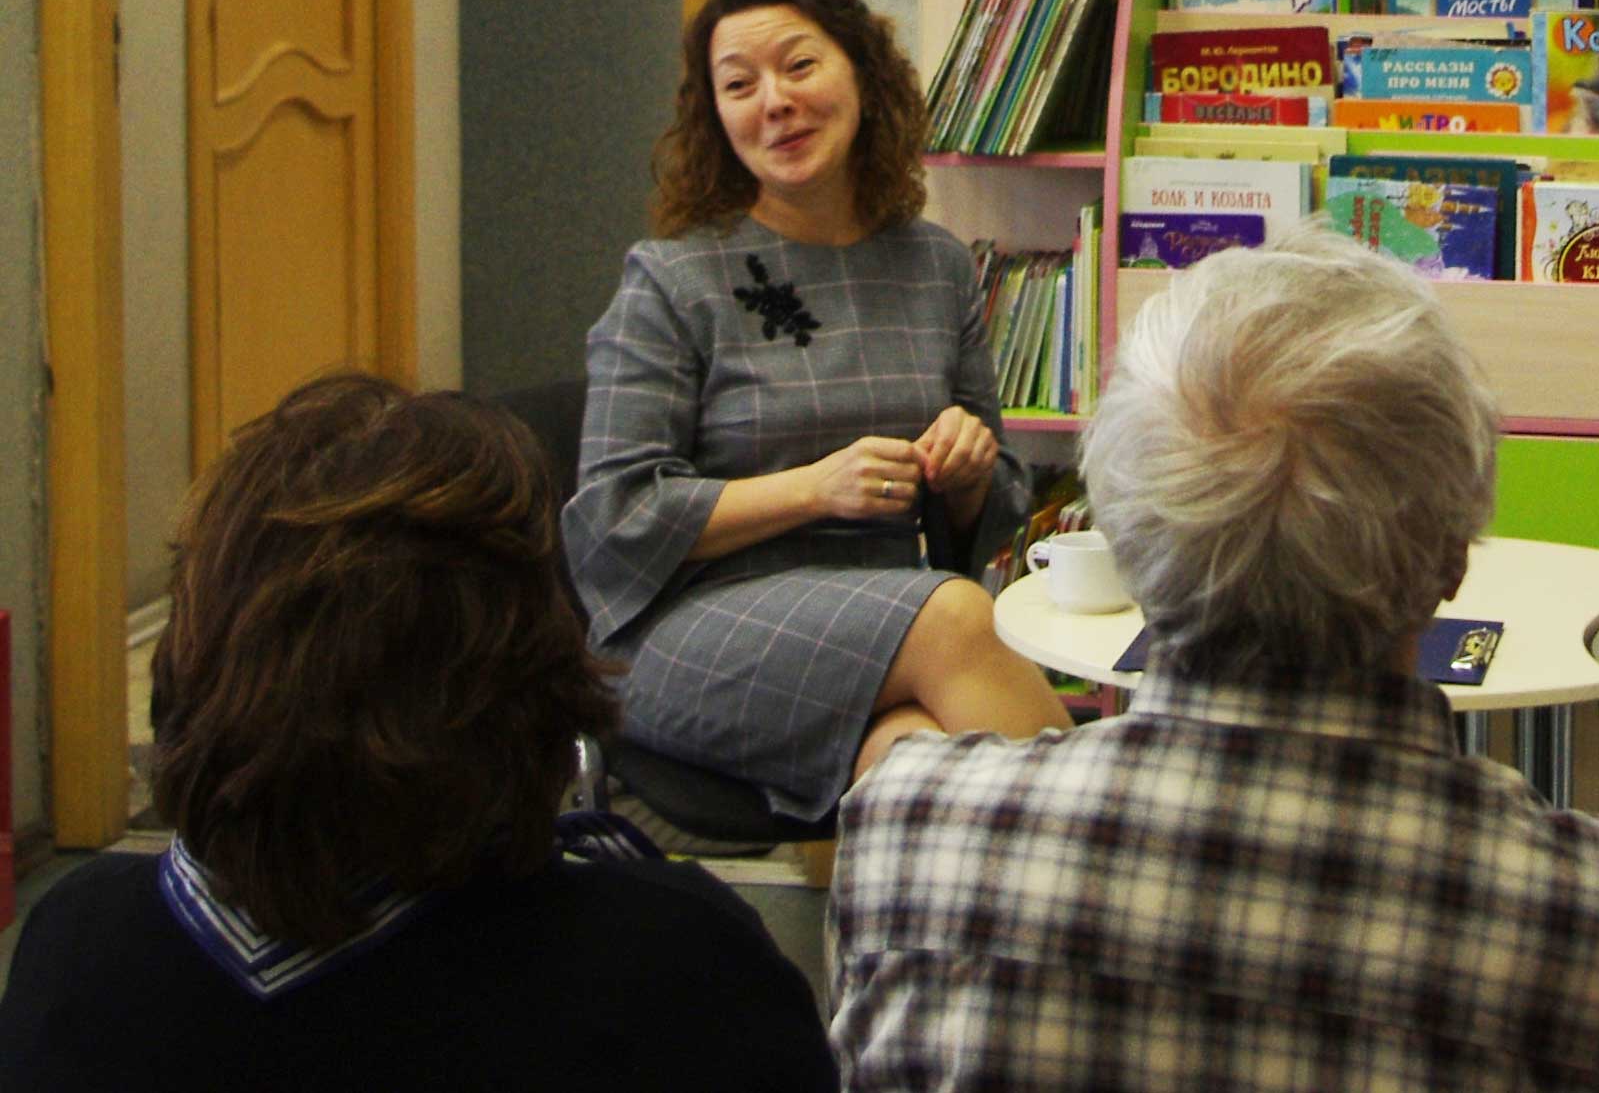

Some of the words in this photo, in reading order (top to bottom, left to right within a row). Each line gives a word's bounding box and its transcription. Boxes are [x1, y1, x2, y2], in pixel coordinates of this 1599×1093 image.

[1382, 61, 1475, 74] РАССКАЗЫ
[1161, 60, 1323, 95] БОРОДИНО
[1387, 76, 1420, 88] ПРО
[1425, 76, 1471, 89] МЕНЯ
[1194, 190, 1204, 207] И
